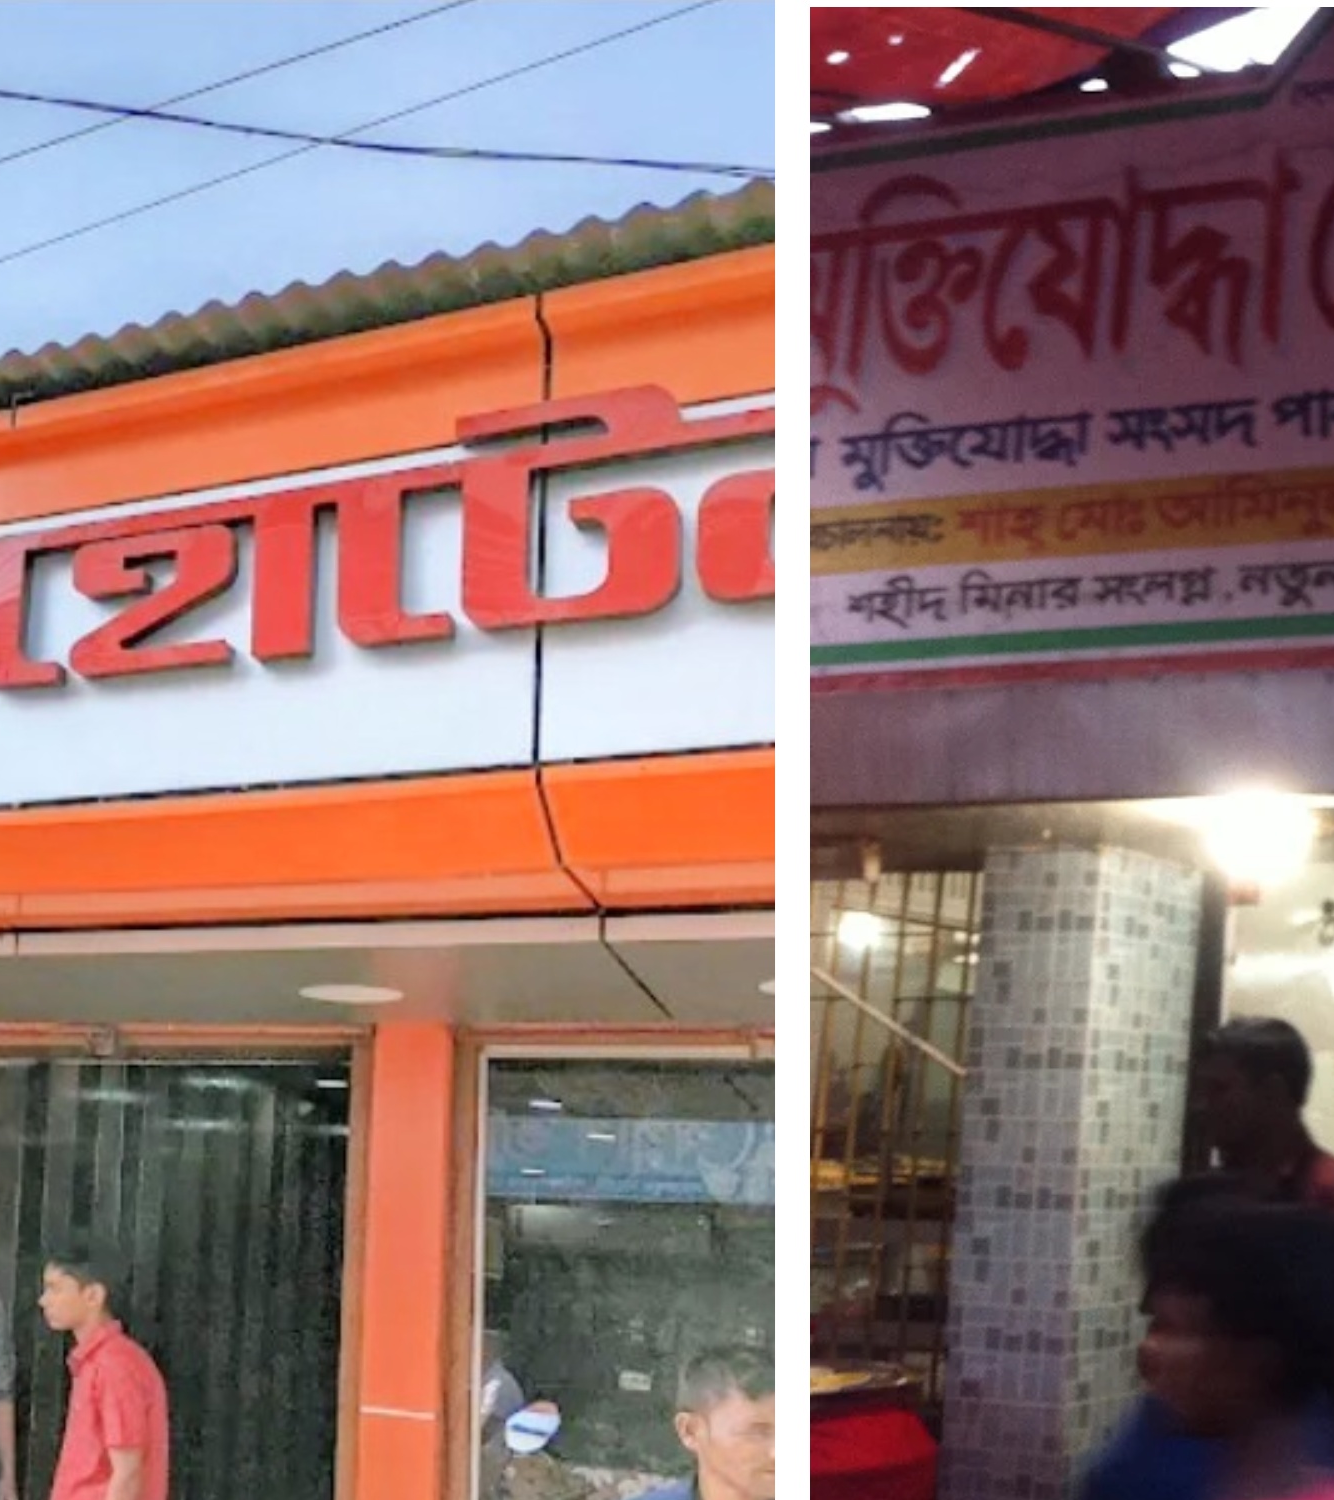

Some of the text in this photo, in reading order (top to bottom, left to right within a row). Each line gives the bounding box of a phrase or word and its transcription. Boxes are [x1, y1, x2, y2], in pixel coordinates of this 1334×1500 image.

[841, 410, 1094, 492] মুক্তিযোদ্ধা
[1105, 396, 1262, 452] সংসদ
[848, 575, 947, 629] শহীদ
[959, 568, 1081, 617] মিনার
